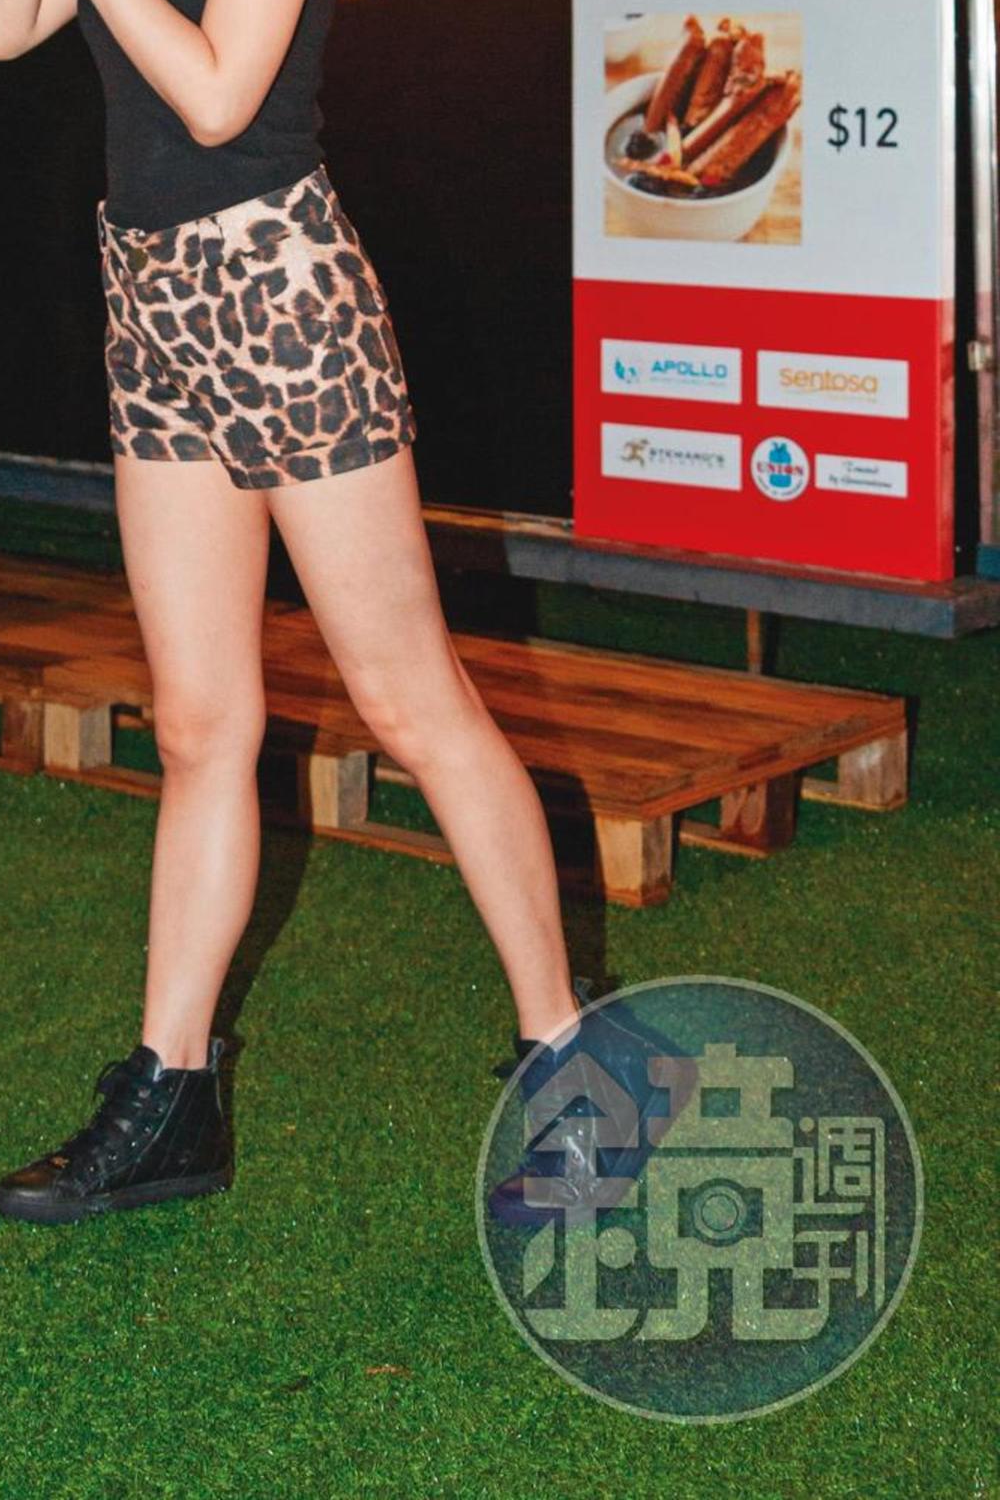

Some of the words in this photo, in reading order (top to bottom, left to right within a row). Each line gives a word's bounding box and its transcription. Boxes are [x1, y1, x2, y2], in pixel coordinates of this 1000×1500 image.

[827, 103, 898, 152] $12
[651, 360, 728, 379] APOLLO
[779, 367, 879, 394] sentosa
[757, 461, 804, 476] UNION
